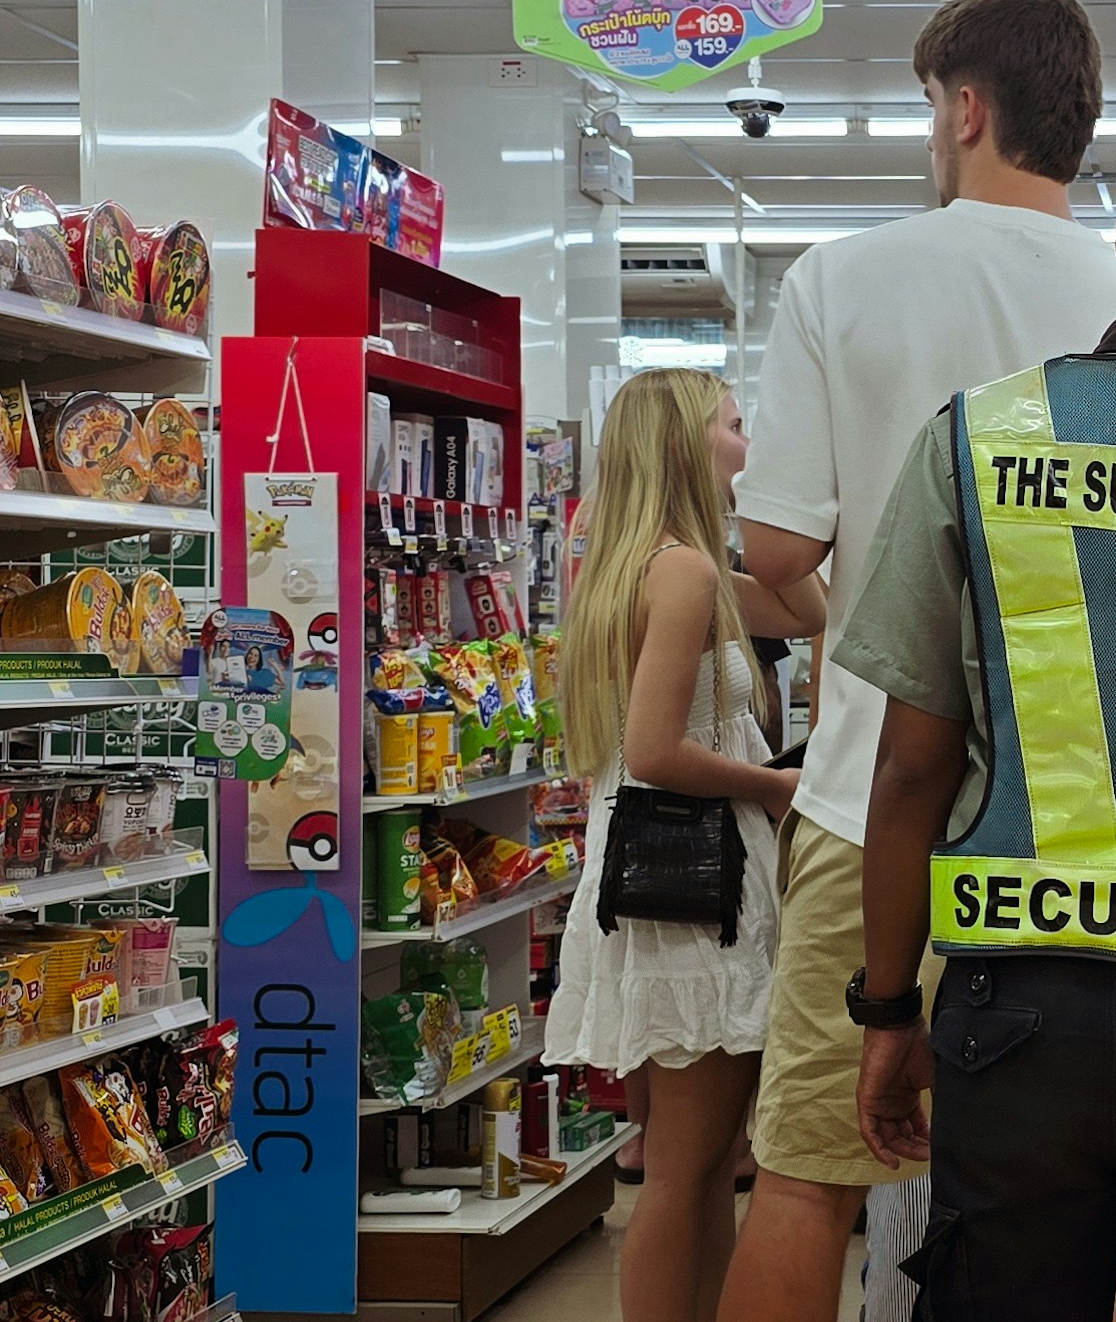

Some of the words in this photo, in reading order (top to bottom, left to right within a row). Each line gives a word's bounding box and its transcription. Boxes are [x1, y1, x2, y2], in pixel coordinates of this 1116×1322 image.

[579, 7, 671, 37] กระเป๋าโน้ตบุ๊ก
[591, 30, 637, 48] ชวนฝัน
[445, 436, 456, 452] A04
[445, 453, 458, 498] Galaxy
[991, 456, 1068, 509] THE
[235, 632, 250, 640] ALL
[250, 634, 289, 646] member
[0, 660, 32, 670] PRODUCTS
[37, 660, 62, 670] PRODUK
[233, 692, 278, 703] privileges
[400, 854, 420, 868] STA
[252, 983, 337, 1174] dtac
[14, 1212, 36, 1232] HALAL
[35, 1200, 70, 1223] PRODUCTS
[73, 1187, 98, 1207] PRODUK
[98, 1179, 118, 1195] HALAL
